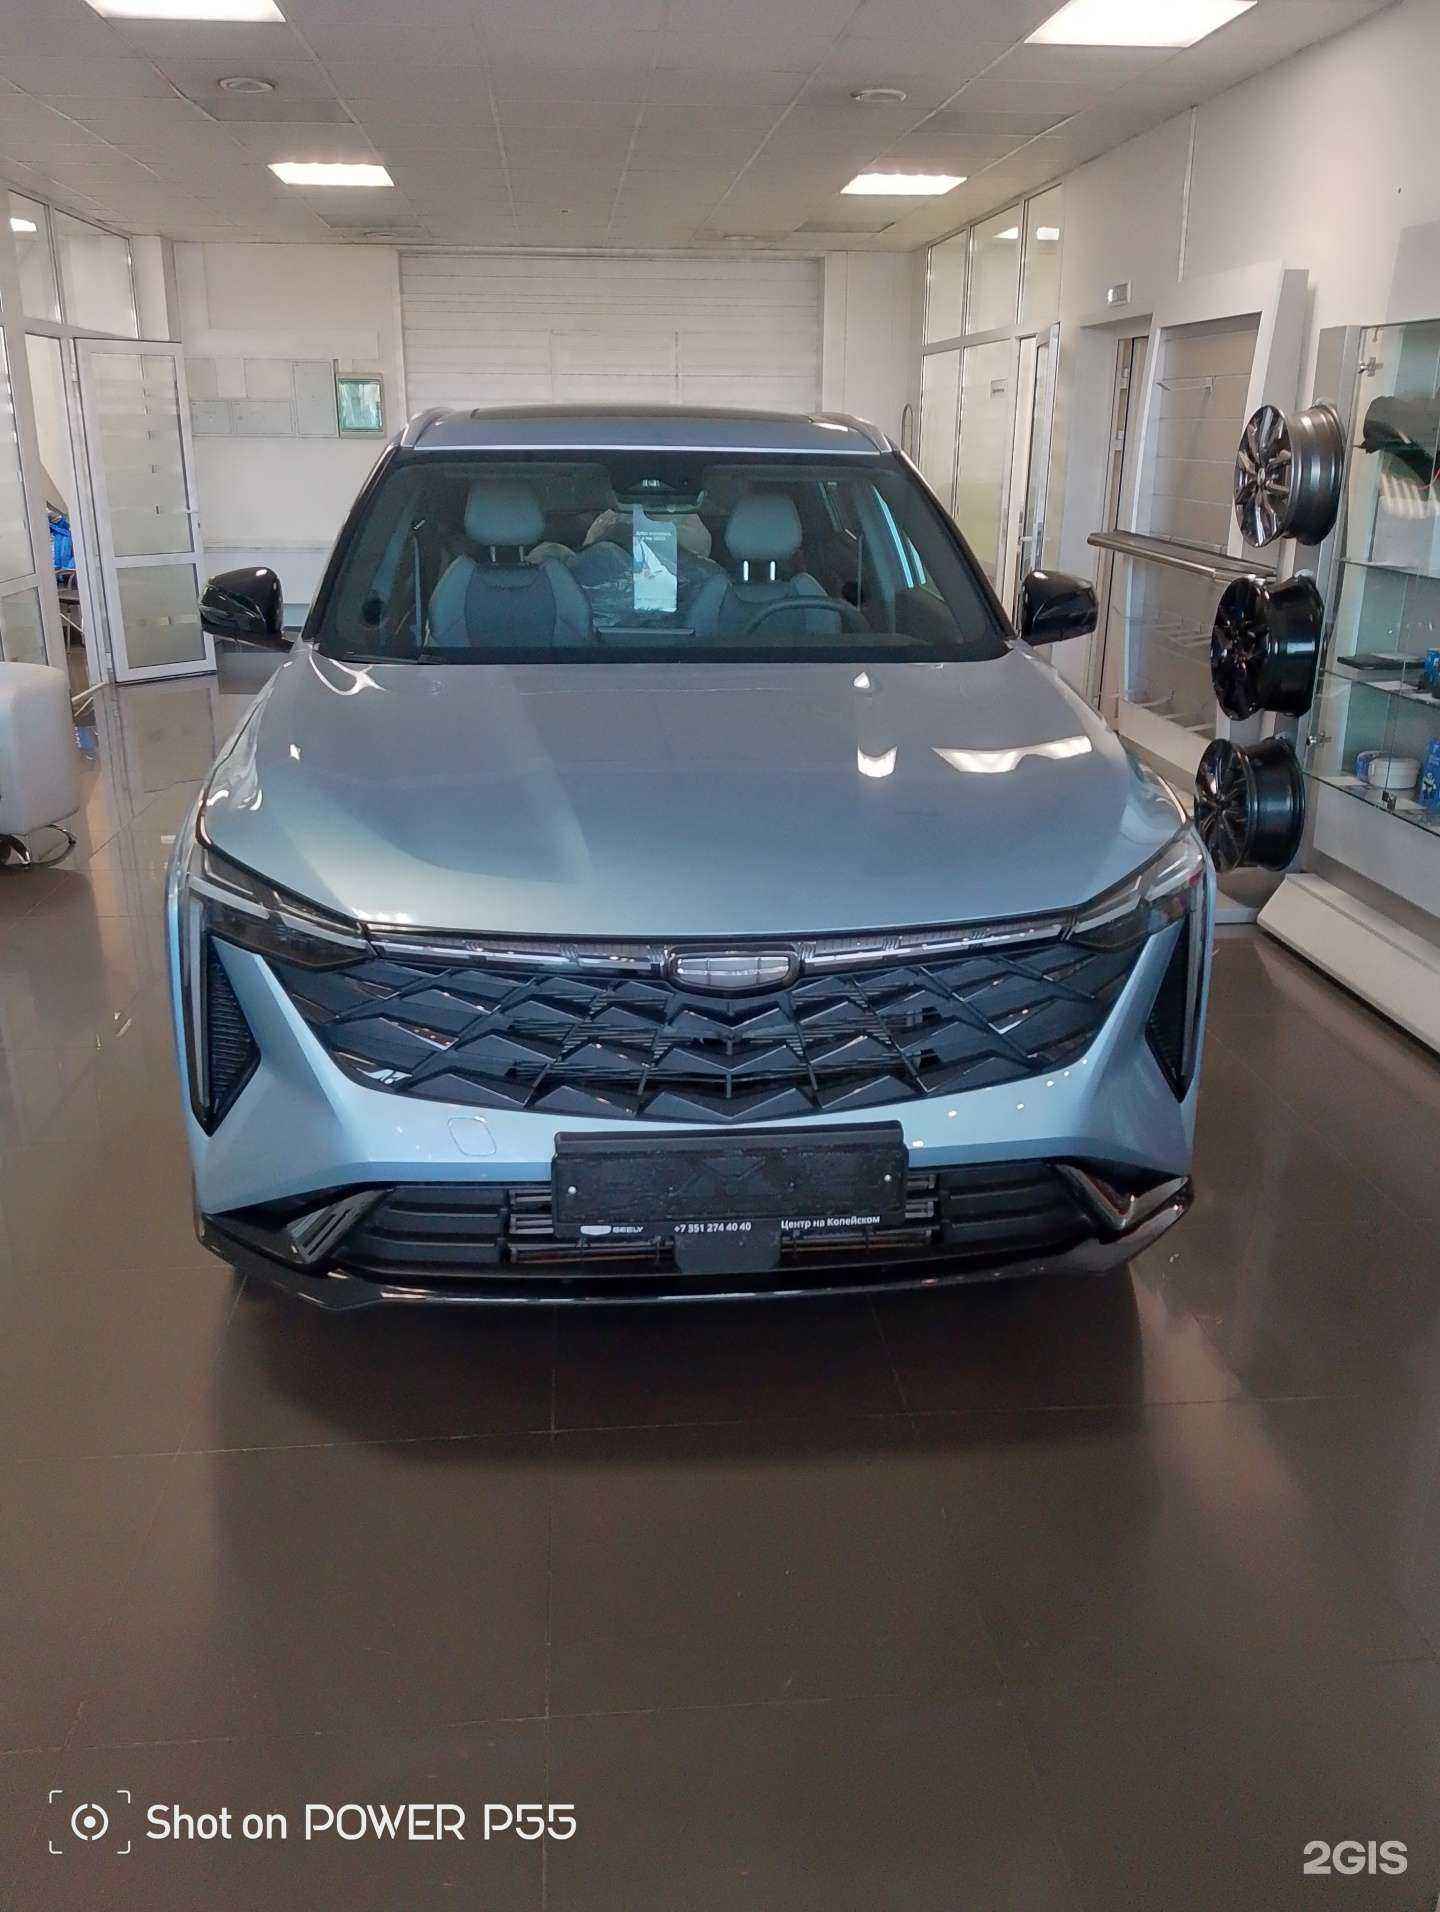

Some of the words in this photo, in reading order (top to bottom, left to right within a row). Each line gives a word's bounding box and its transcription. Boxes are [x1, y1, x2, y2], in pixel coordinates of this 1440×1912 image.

[725, 1222, 739, 1232] 40
[739, 1221, 752, 1232] 40
[780, 1219, 812, 1231] Центр
[826, 1215, 881, 1227] Копейском
